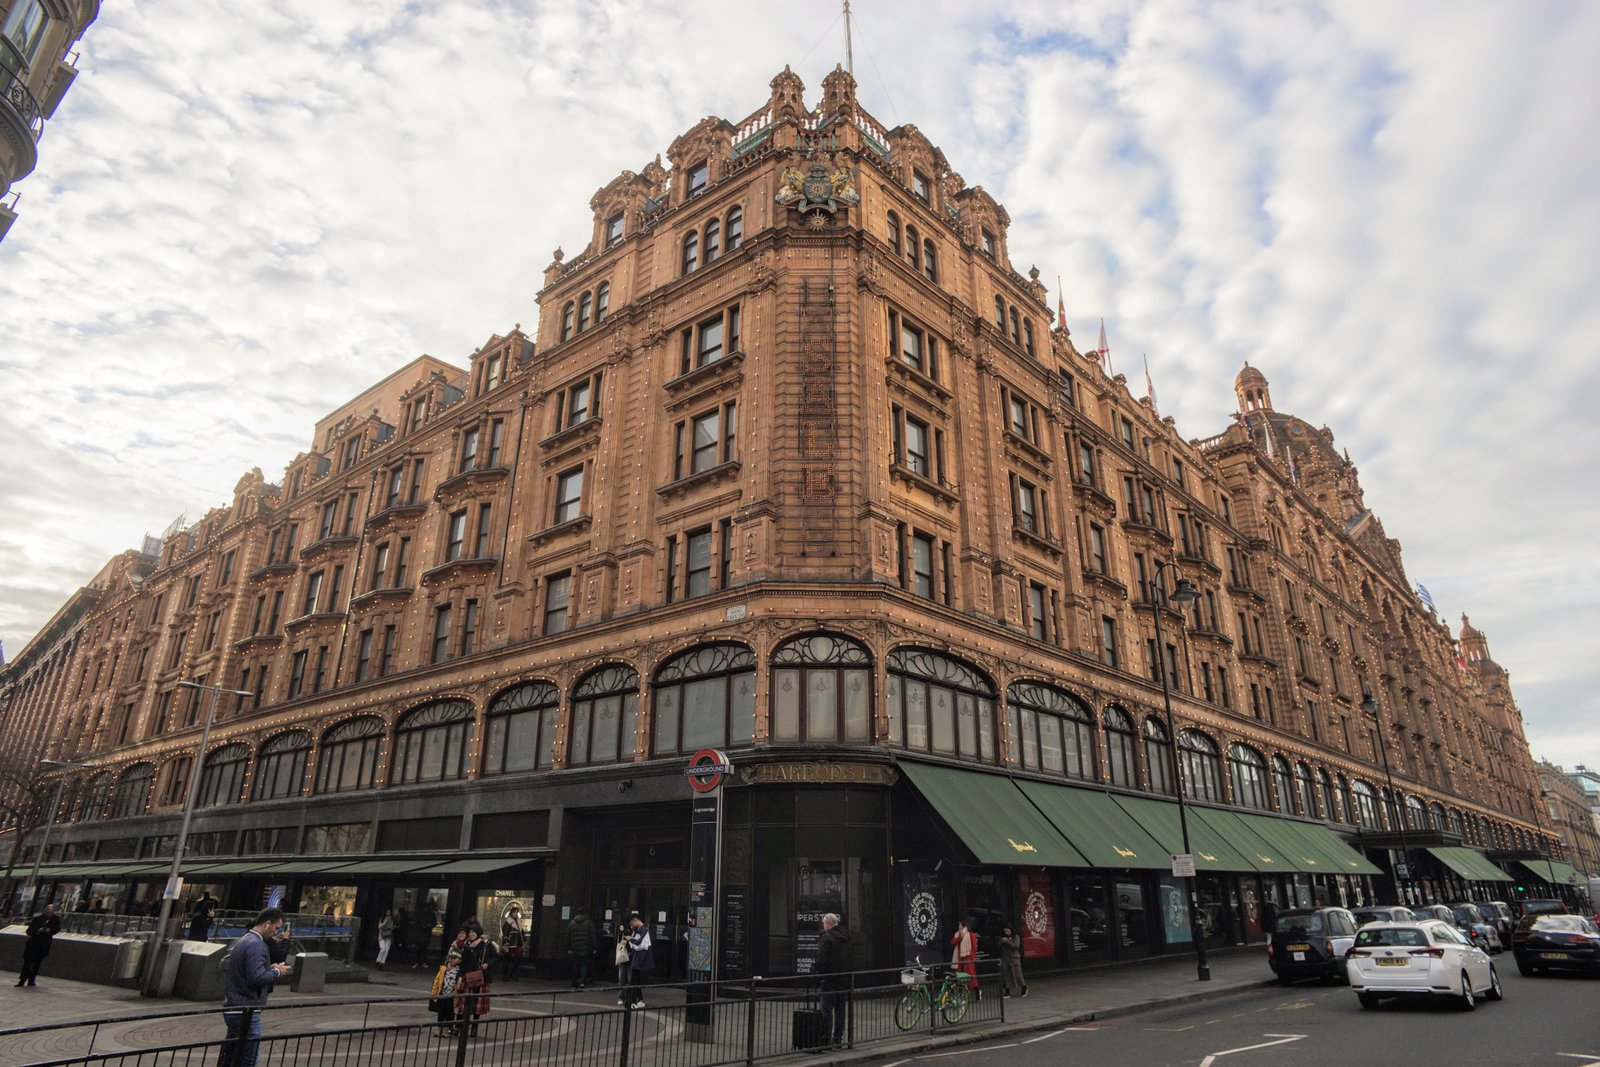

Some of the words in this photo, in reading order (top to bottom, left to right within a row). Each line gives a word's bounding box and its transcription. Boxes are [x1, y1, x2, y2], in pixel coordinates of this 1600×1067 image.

[801, 339, 837, 500] SALE
[685, 765, 725, 775] UNDERGROUND
[495, 889, 515, 897] CHANEL
